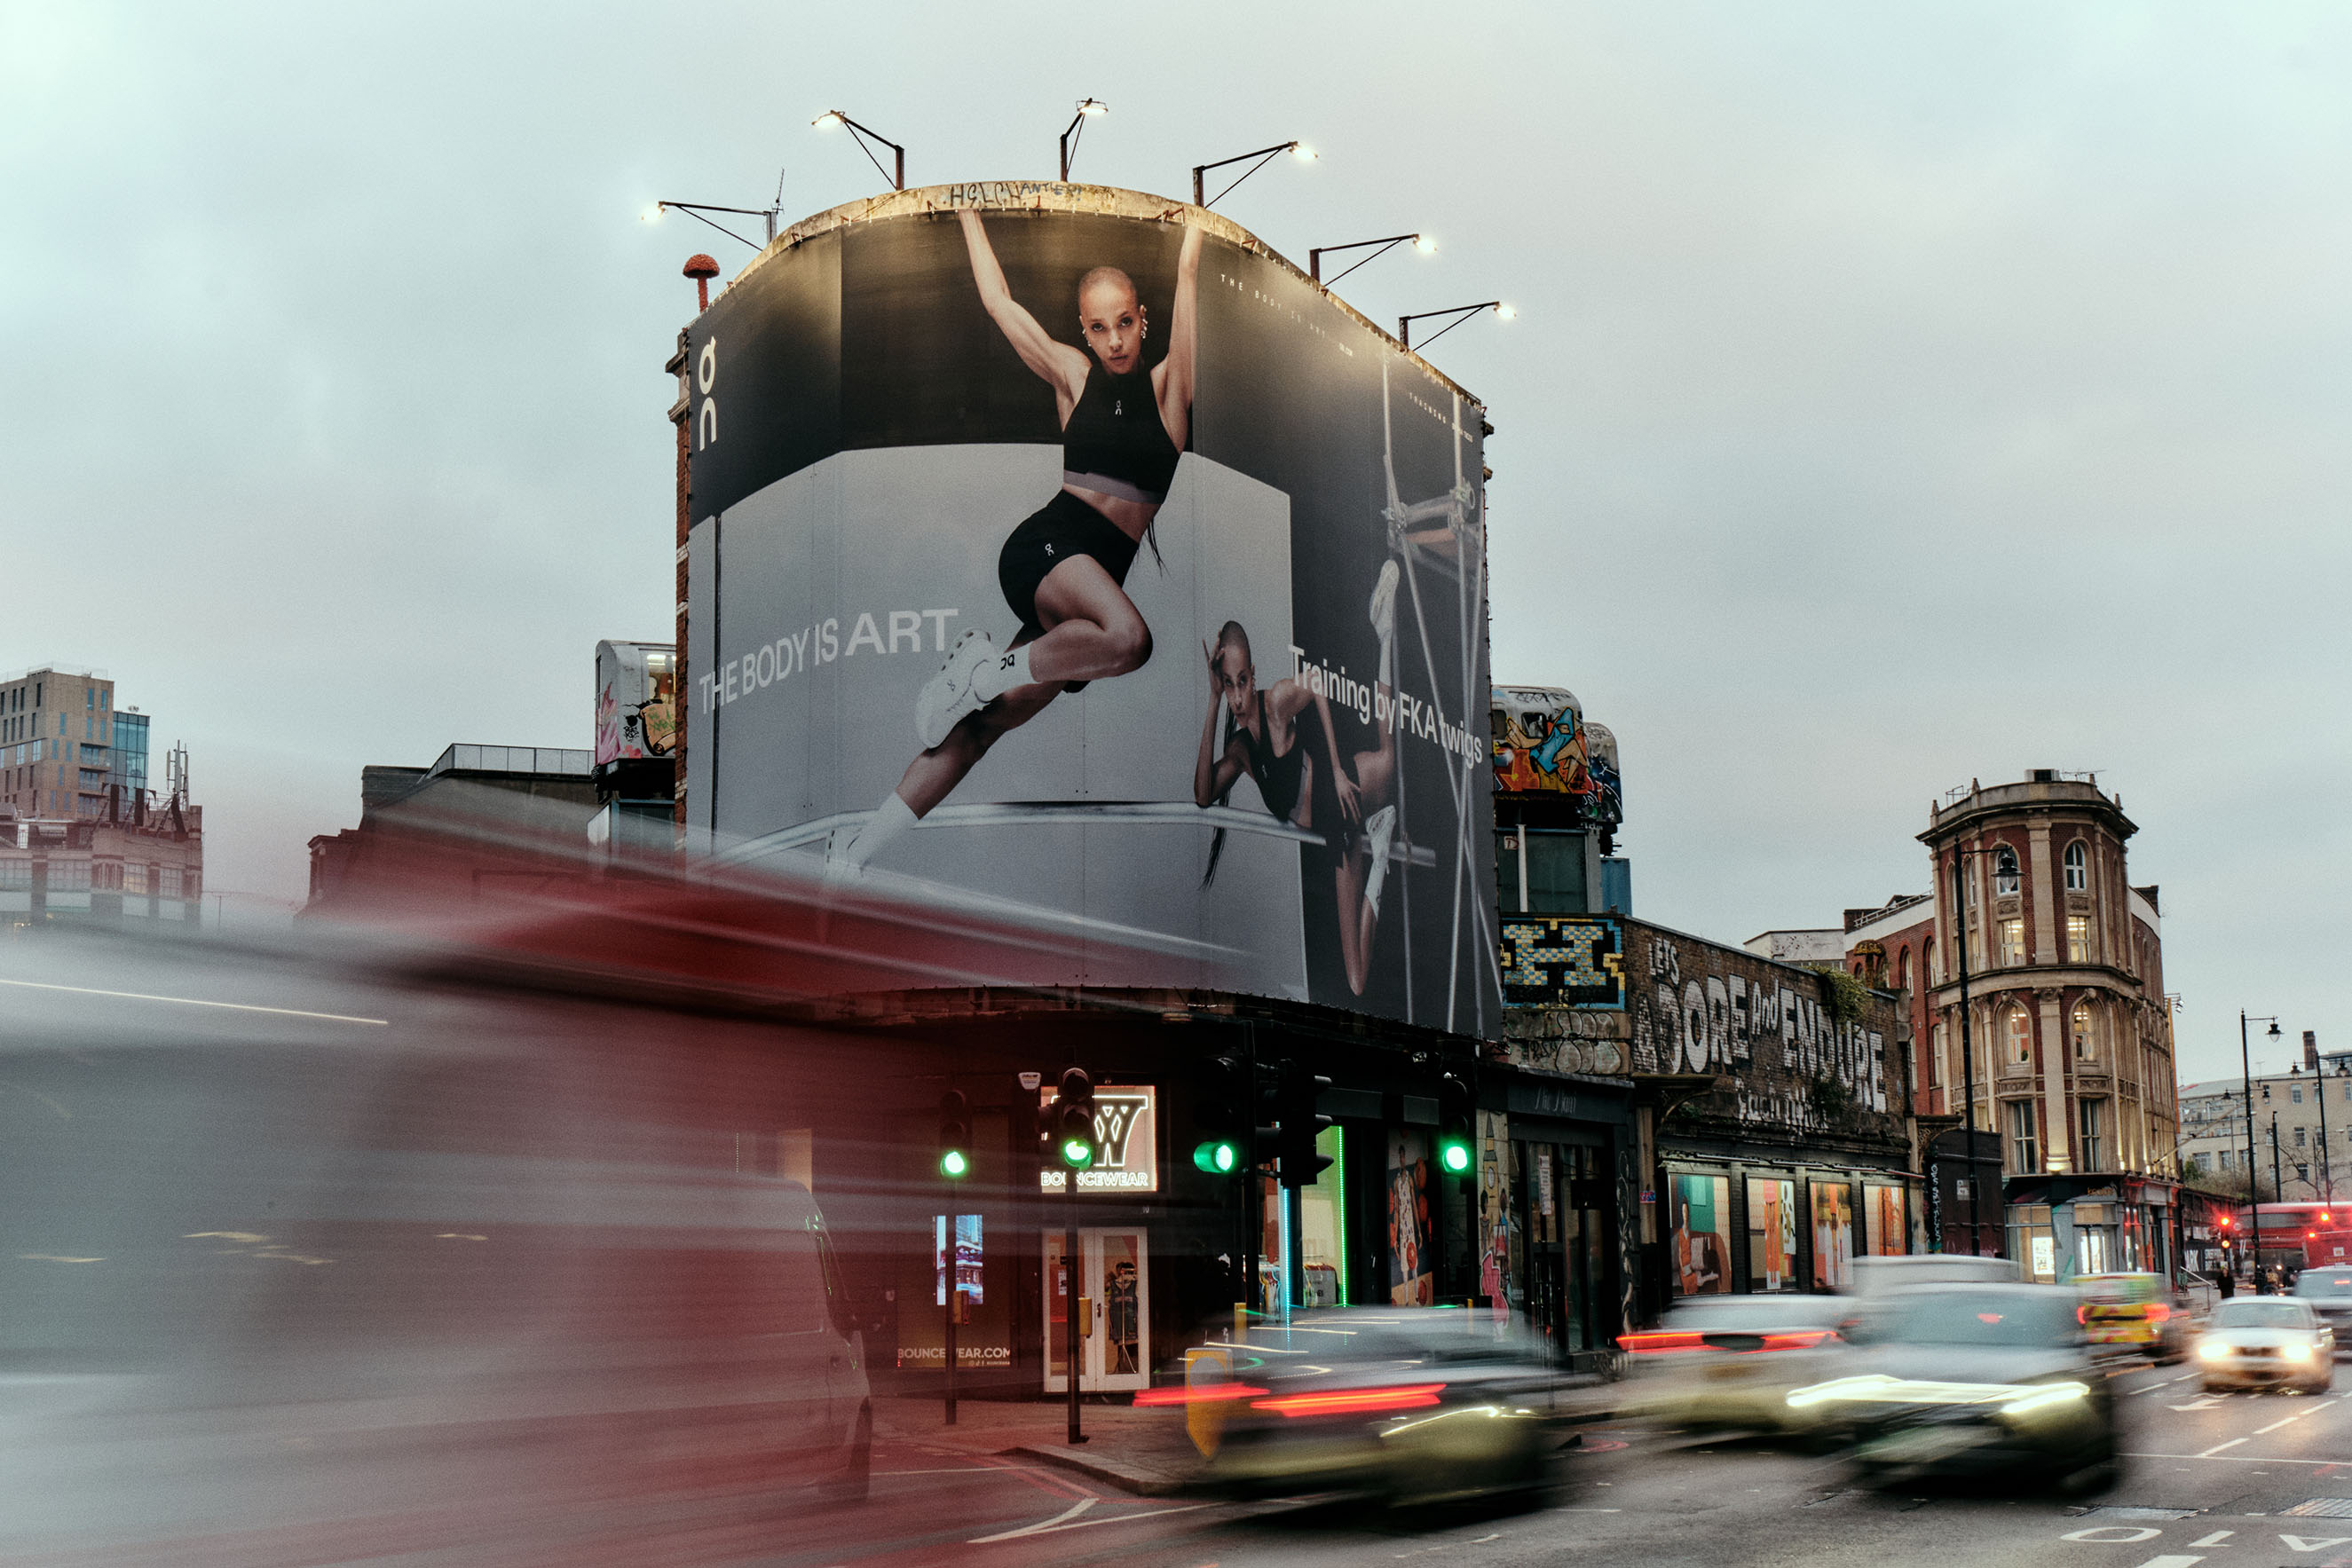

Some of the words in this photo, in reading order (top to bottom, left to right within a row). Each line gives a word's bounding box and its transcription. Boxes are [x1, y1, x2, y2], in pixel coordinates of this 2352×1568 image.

[1220, 273, 1243, 291] THE
[1255, 290, 1282, 311] BODY
[698, 660, 738, 714] THE
[742, 627, 810, 696] BODY
[814, 618, 839, 666] IS
[845, 609, 959, 657] ART
[1289, 645, 1370, 725] Training
[1374, 681, 1396, 735] by
[1399, 690, 1439, 745] FKA
[1439, 712, 1483, 769] twigs
[1633, 974, 1749, 1075] ADORE
[1780, 987, 1888, 1115] ENDURE
[897, 1347, 1011, 1359] BOUNCEEAR.COM
